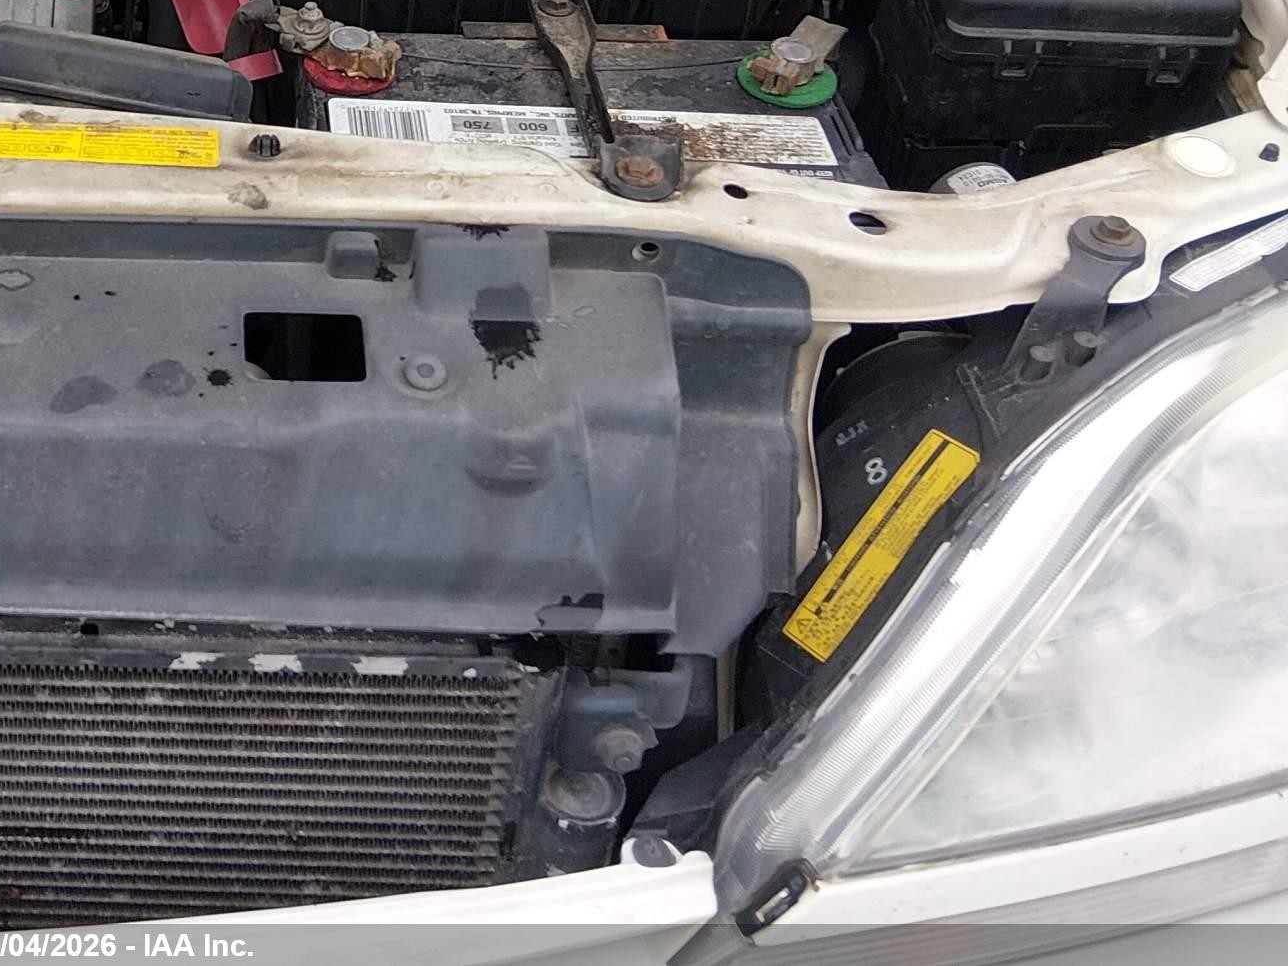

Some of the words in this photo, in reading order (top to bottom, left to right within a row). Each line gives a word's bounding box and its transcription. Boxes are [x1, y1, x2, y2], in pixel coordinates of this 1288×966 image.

[463, 120, 493, 130] 750
[518, 122, 547, 132] 600
[865, 457, 888, 485] 8
